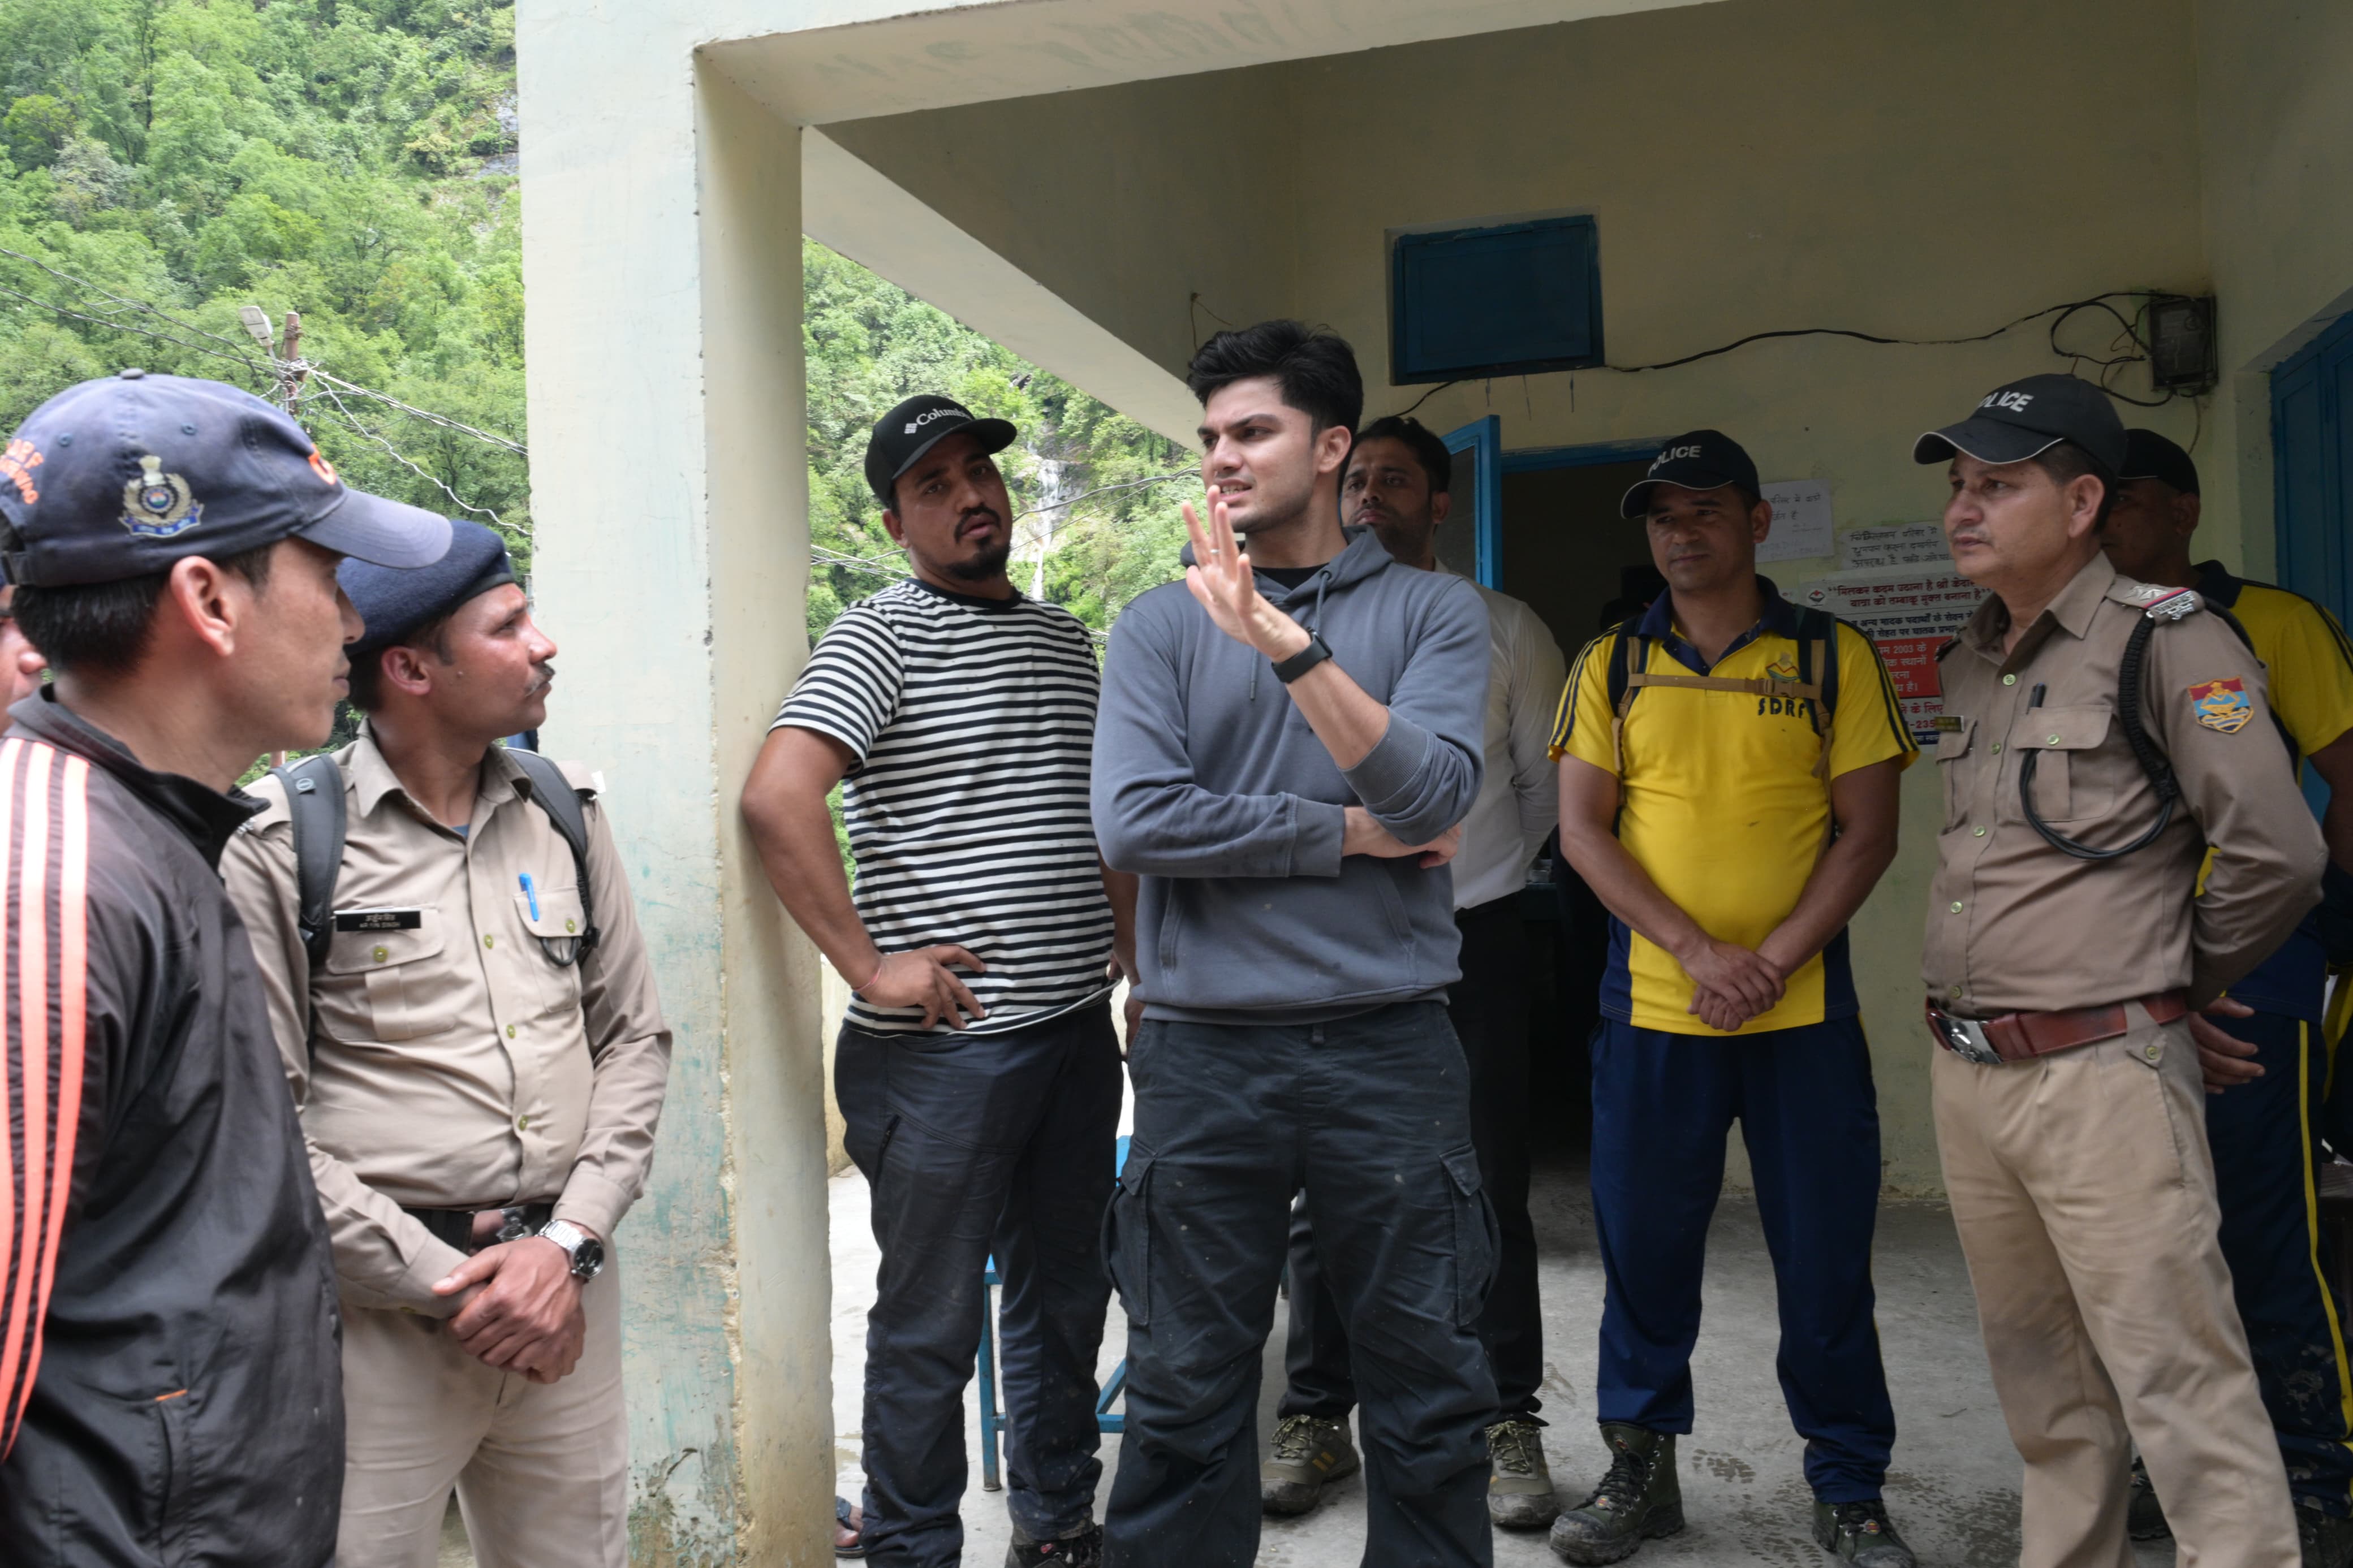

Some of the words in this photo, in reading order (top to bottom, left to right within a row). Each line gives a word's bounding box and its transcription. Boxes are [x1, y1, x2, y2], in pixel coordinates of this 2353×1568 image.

[1978, 391, 2035, 412] OLICE
[1872, 585, 1894, 593] कदम
[1897, 583, 1923, 591] उठाना
[1926, 579, 1933, 591] है
[1936, 578, 1949, 589] श्री
[1873, 595, 1886, 606] को
[1920, 594, 1941, 606] मुक्त
[1944, 592, 1971, 601] बनाना
[1932, 612, 1942, 621] के
[1893, 645, 1914, 654] 2003
[1916, 642, 1927, 652] के
[1910, 703, 1921, 714] के
